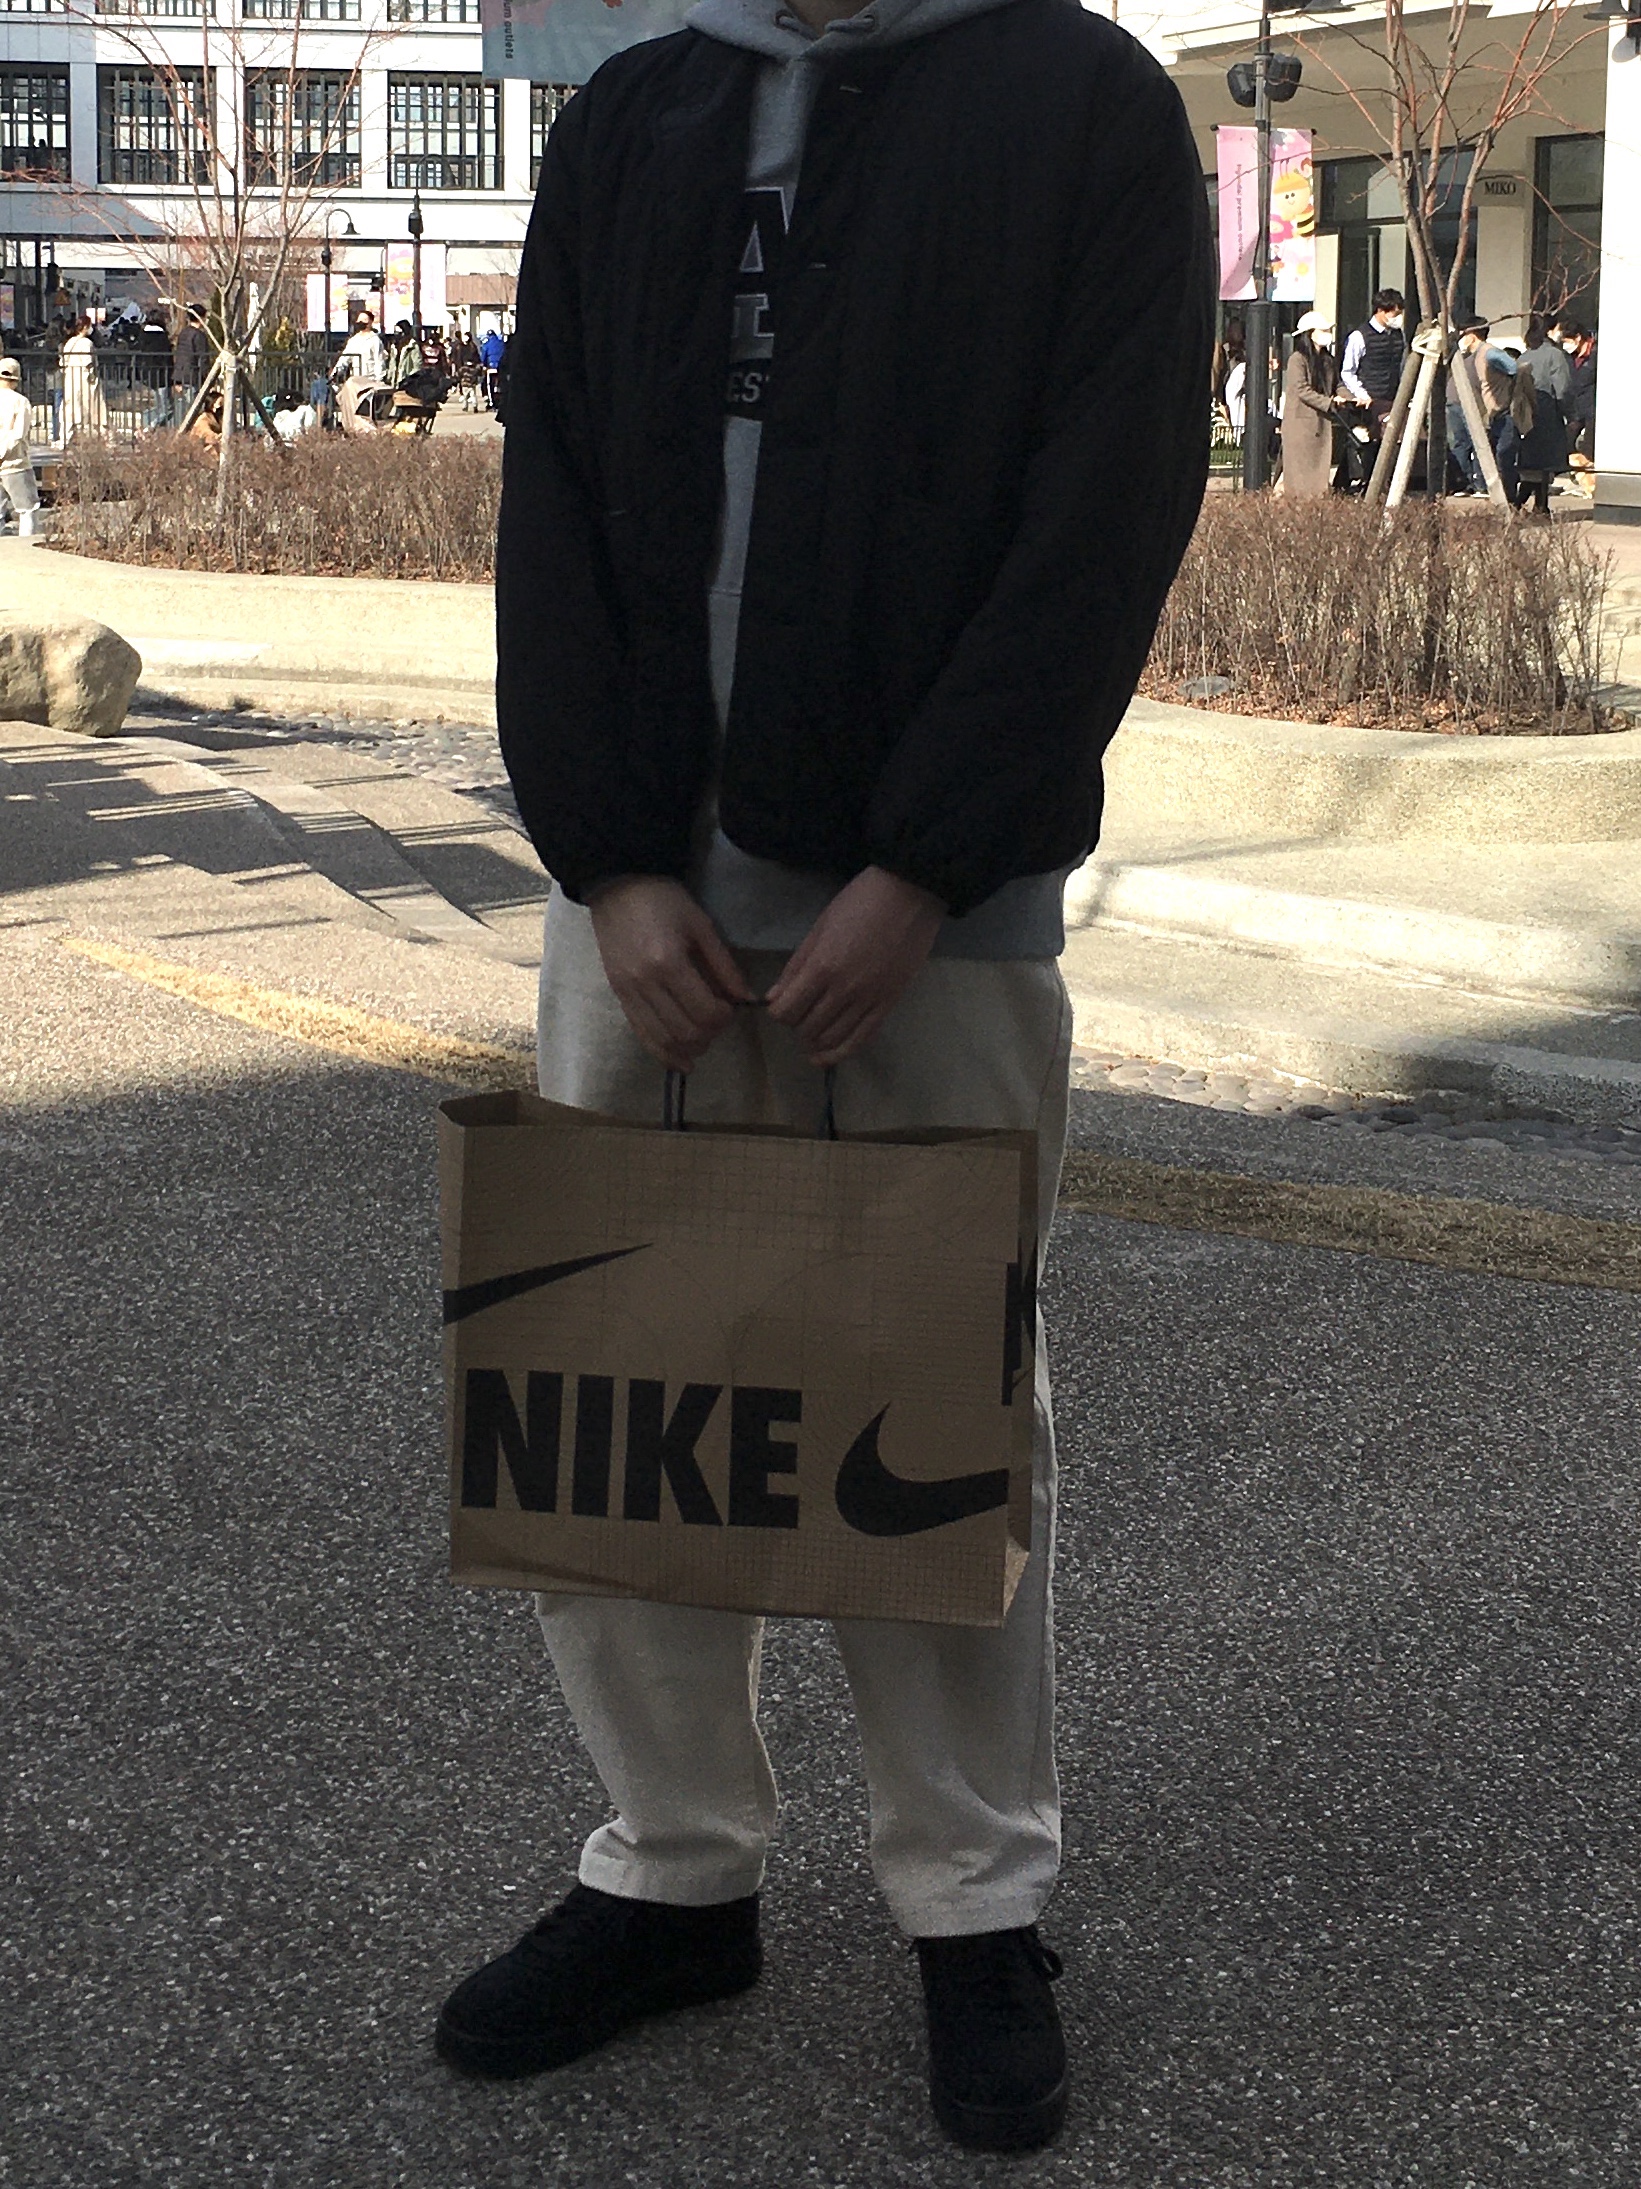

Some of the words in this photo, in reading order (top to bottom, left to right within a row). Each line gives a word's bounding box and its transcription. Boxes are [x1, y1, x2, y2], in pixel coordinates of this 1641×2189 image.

[504, 20, 515, 60] outlets
[1484, 181, 1517, 196] MIKO
[460, 1367, 803, 1530] NIKE
